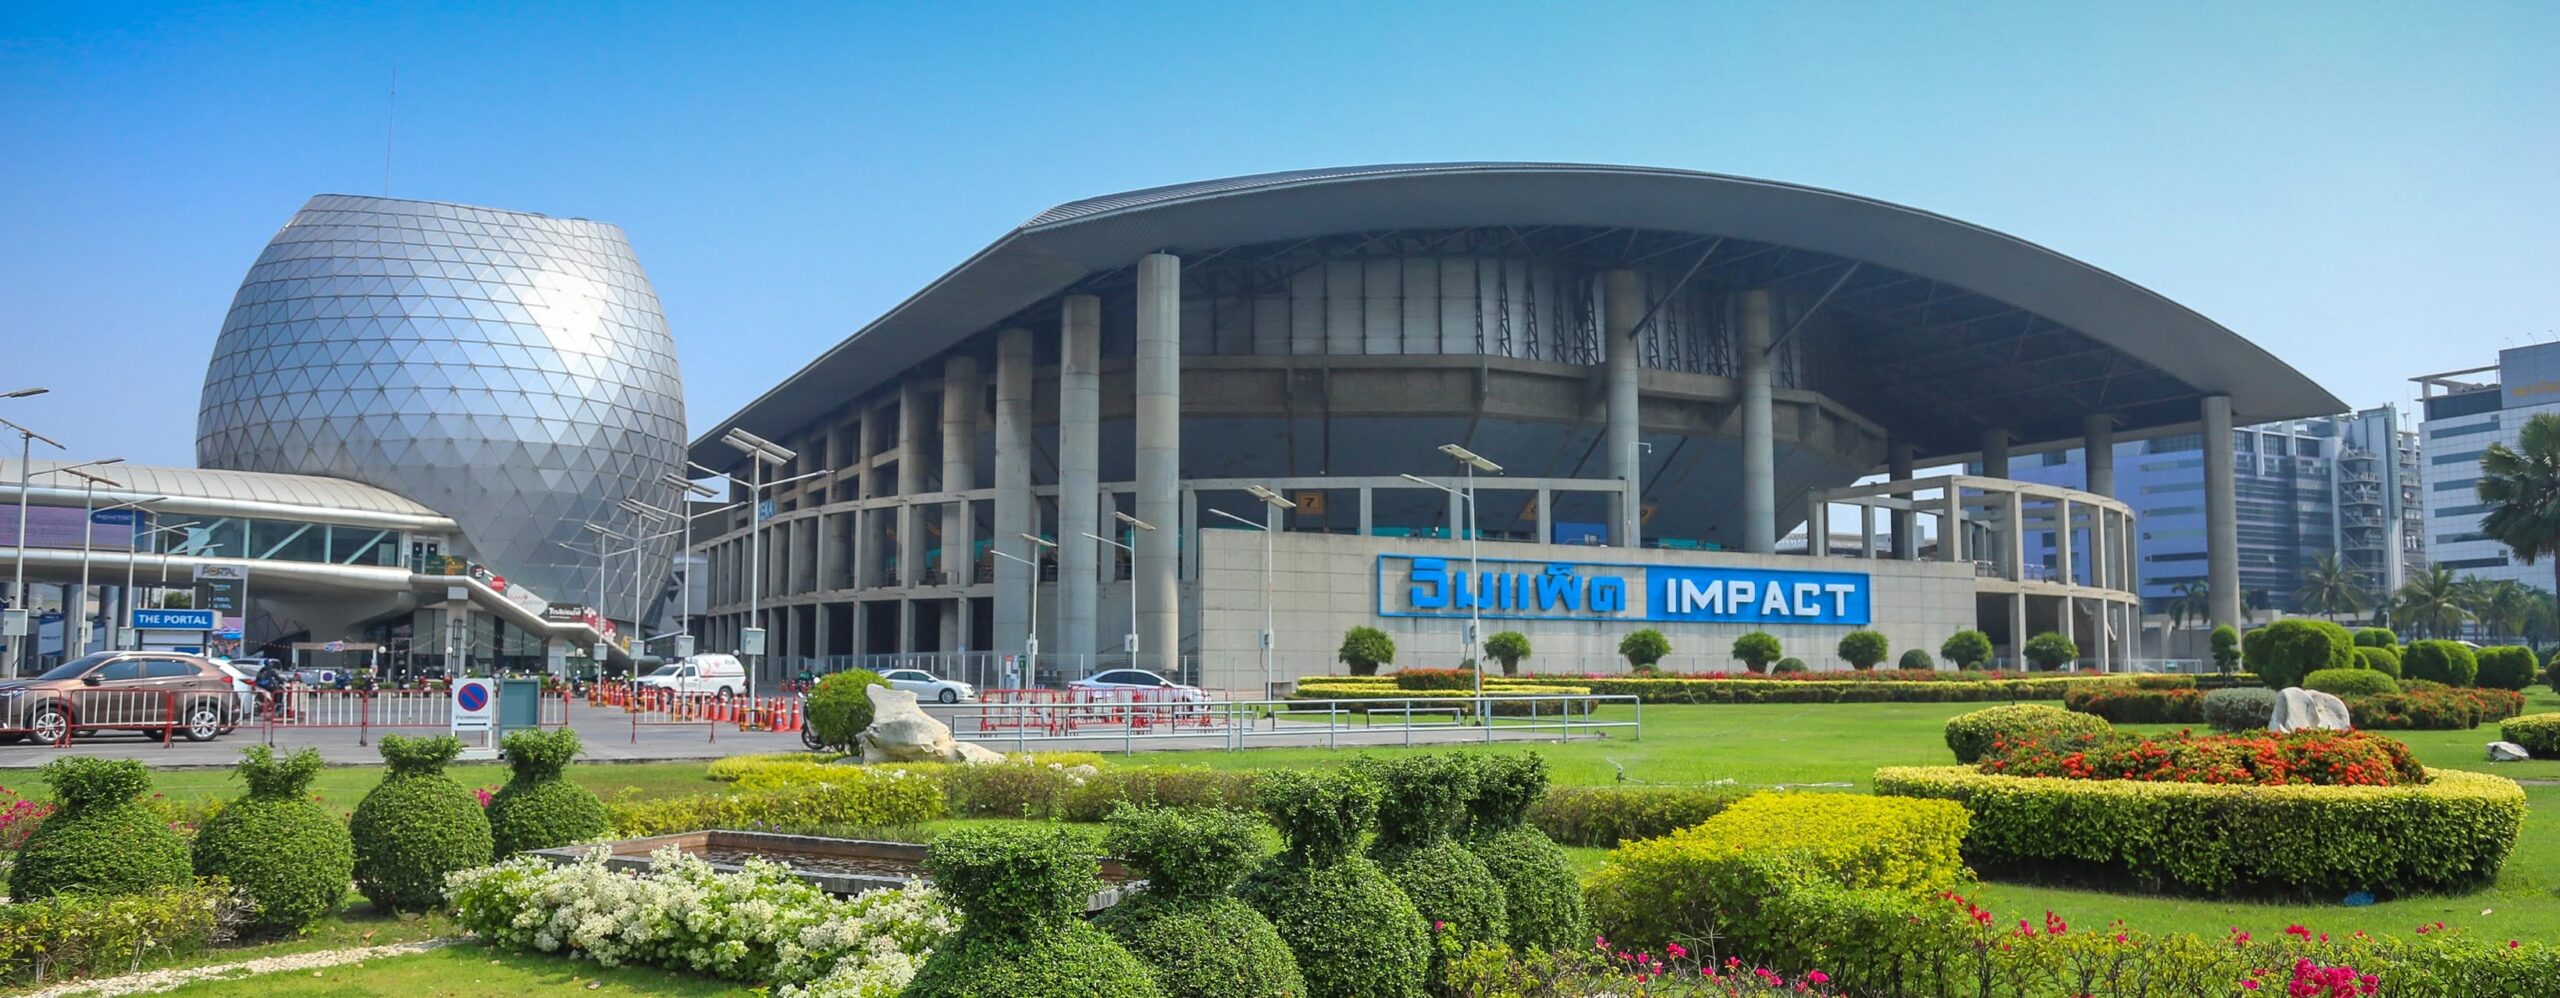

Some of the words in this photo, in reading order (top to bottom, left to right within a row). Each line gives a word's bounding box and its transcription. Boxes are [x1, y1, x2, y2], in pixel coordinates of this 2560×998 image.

[1304, 497, 1315, 508] 7
[201, 565, 240, 577] PORTAL
[1666, 577, 1856, 617] IMPACT
[138, 614, 161, 624] THE
[163, 614, 208, 625] PORTAL
